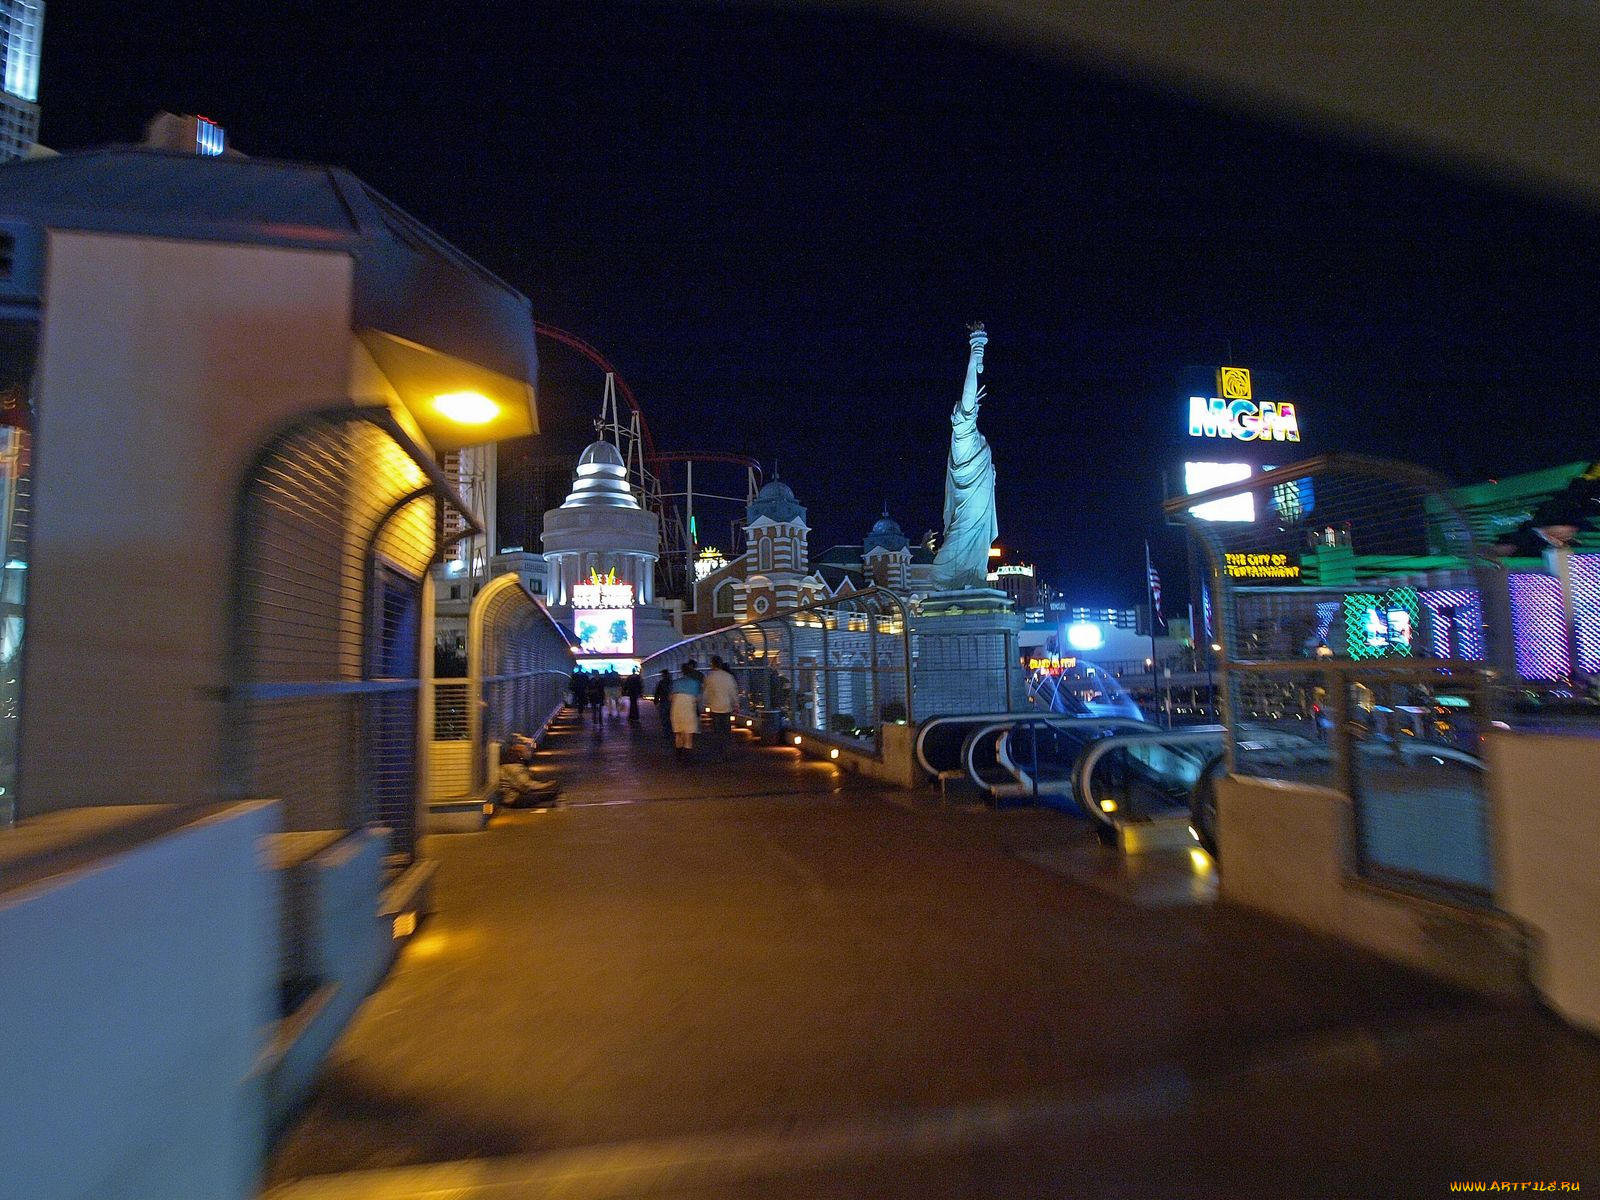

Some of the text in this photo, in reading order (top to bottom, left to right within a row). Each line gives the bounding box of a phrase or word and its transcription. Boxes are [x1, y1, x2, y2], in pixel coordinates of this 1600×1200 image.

[1189, 397, 1301, 442] MGM
[1225, 553, 1287, 566] THE CITY OF
[1215, 565, 1299, 578] TERTAINMENT
